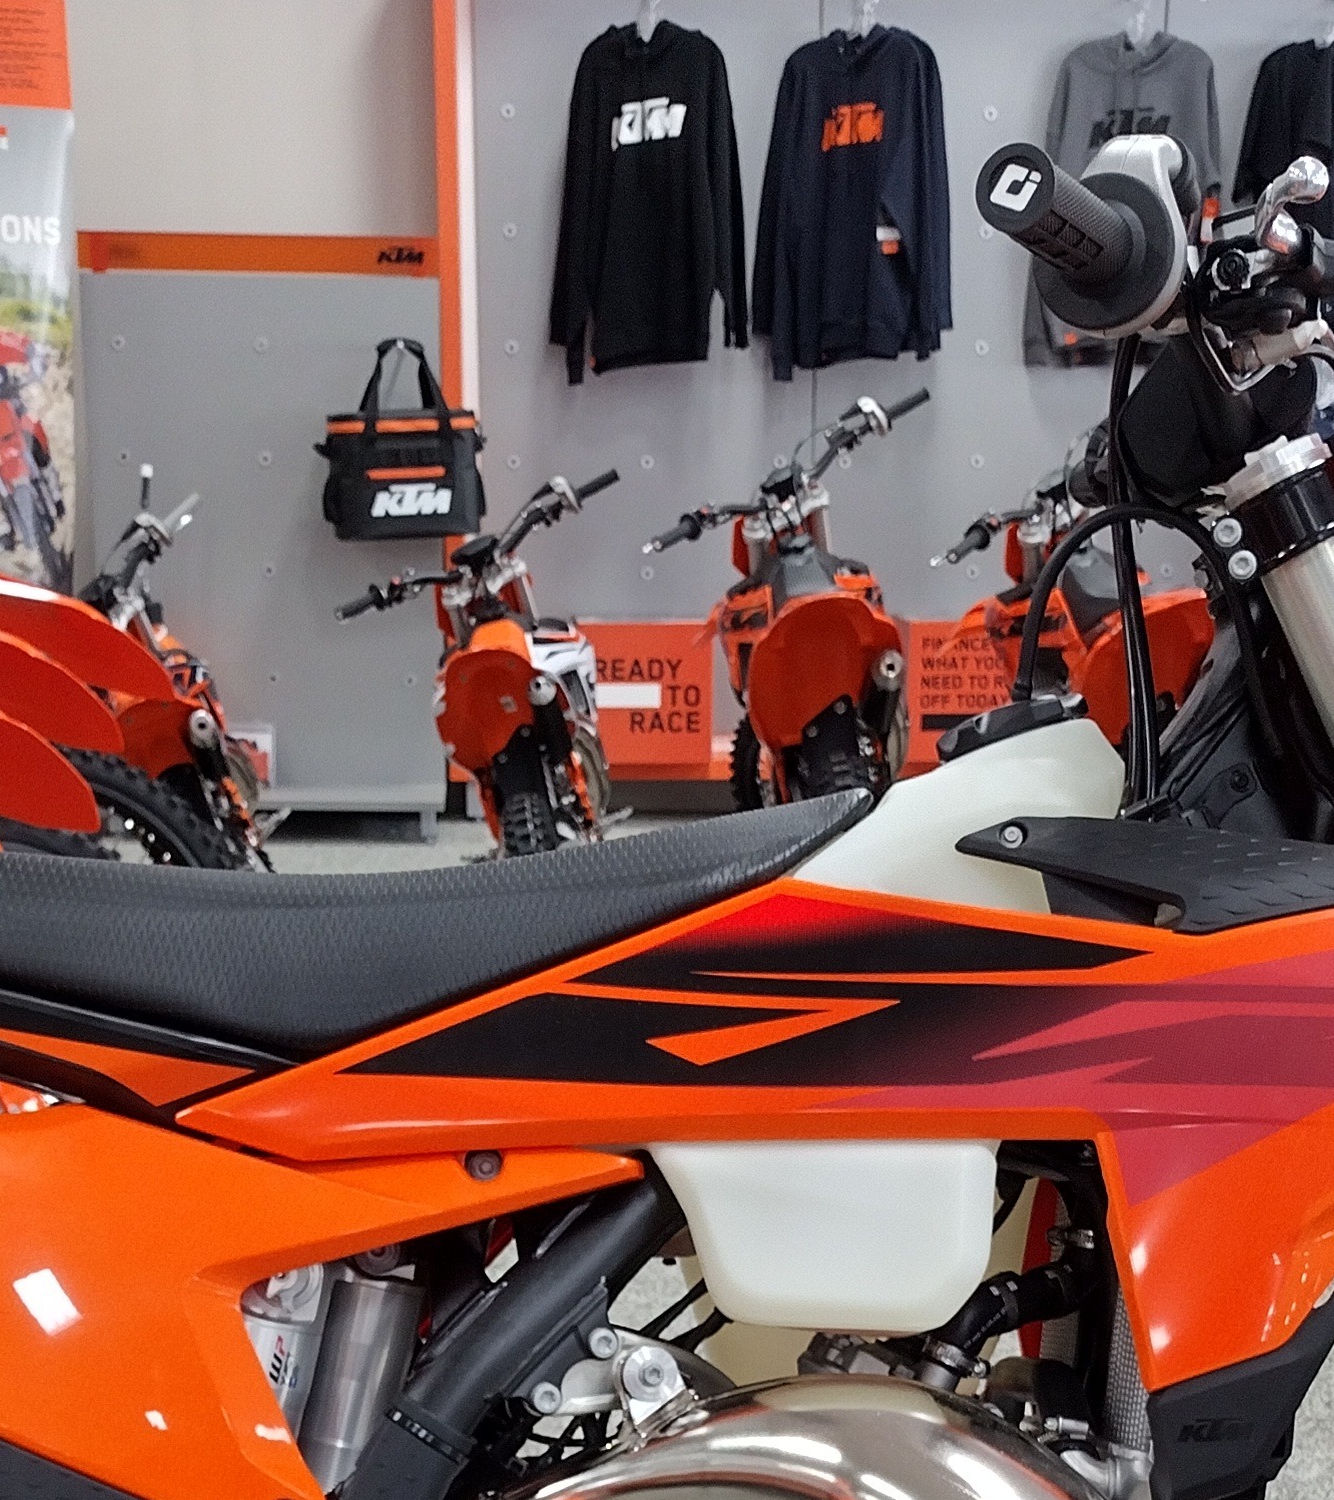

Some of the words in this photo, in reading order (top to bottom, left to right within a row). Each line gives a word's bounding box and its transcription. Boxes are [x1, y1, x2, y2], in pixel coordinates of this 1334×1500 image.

[376, 246, 424, 265] KTM
[371, 483, 452, 517] KTM
[595, 658, 682, 681] READY
[921, 656, 958, 670] WHAT
[921, 675, 962, 690] NEED
[970, 675, 988, 690] TO
[668, 684, 701, 707] TO
[920, 694, 950, 709] OFF
[630, 711, 701, 734] RACE
[1178, 1417, 1254, 1442] KTM
